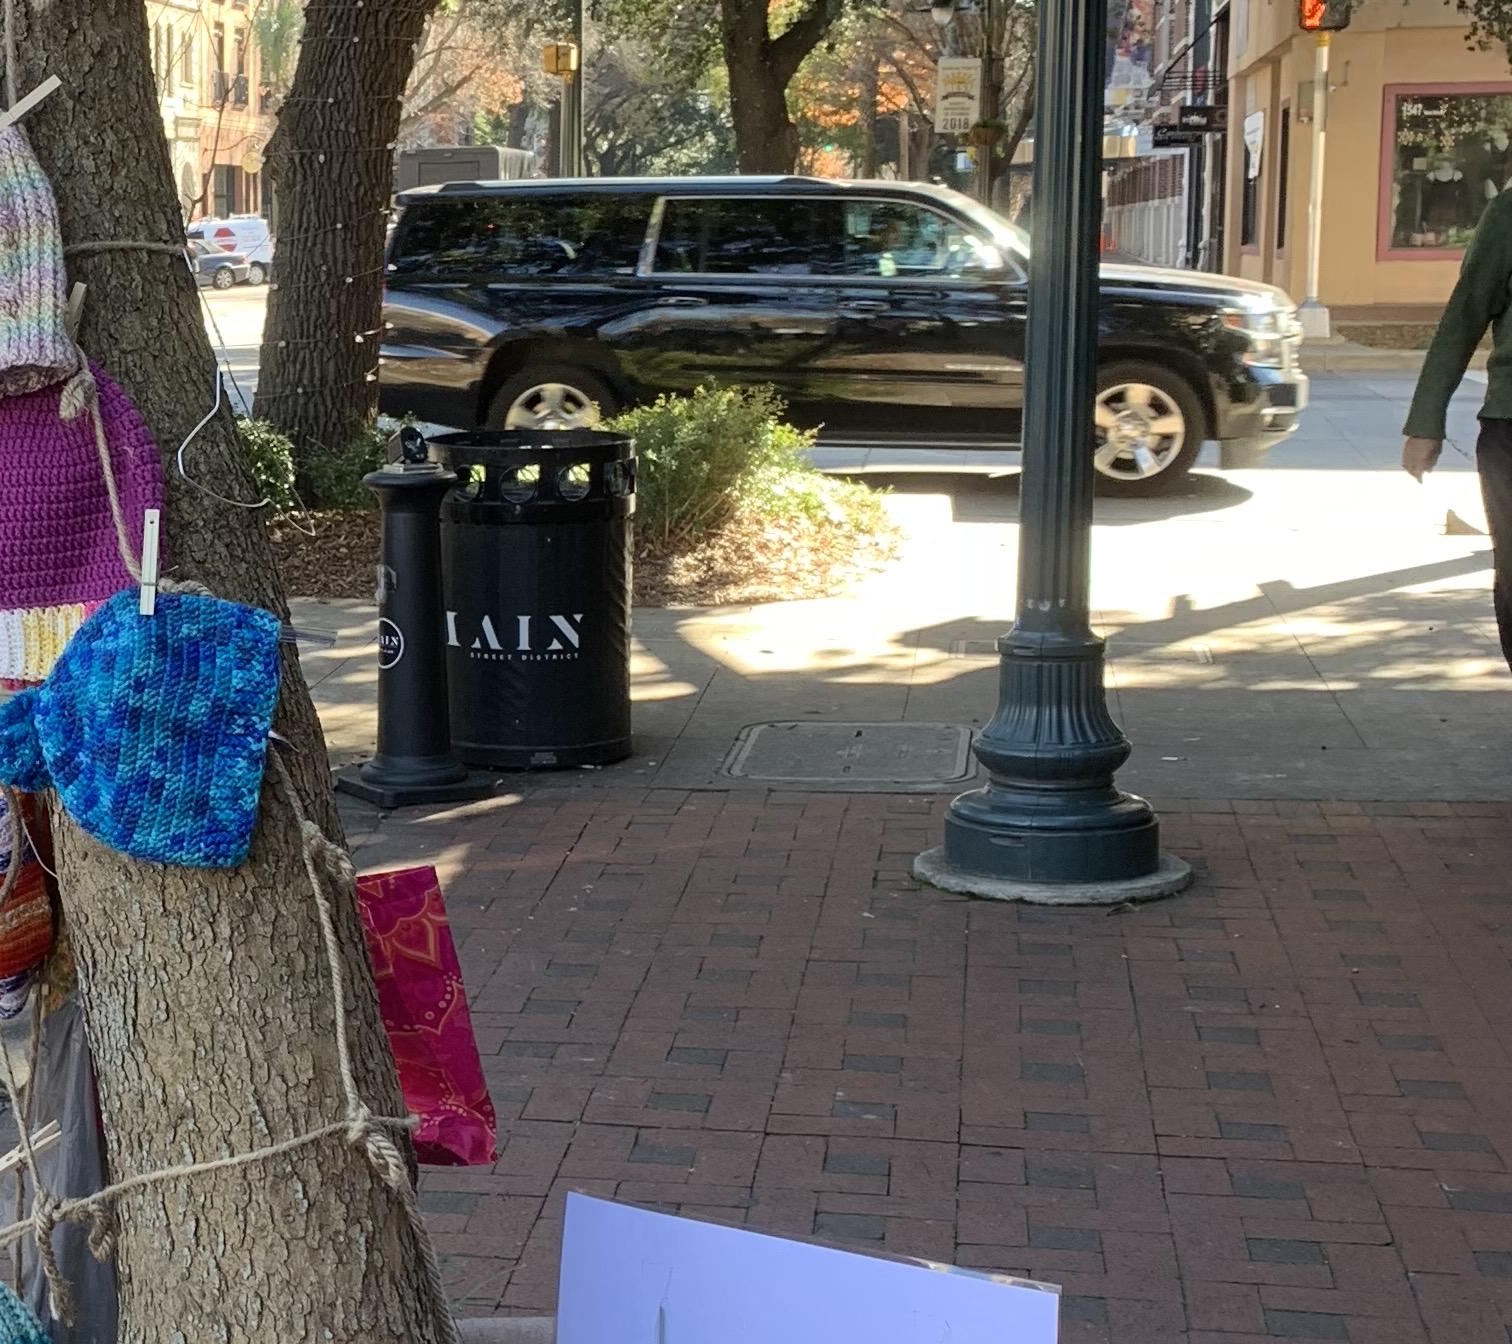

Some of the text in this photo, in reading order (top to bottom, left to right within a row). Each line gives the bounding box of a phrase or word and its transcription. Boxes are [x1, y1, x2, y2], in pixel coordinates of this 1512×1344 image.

[942, 119, 969, 130] 2018
[470, 652, 580, 661] STREET DISTRICT
